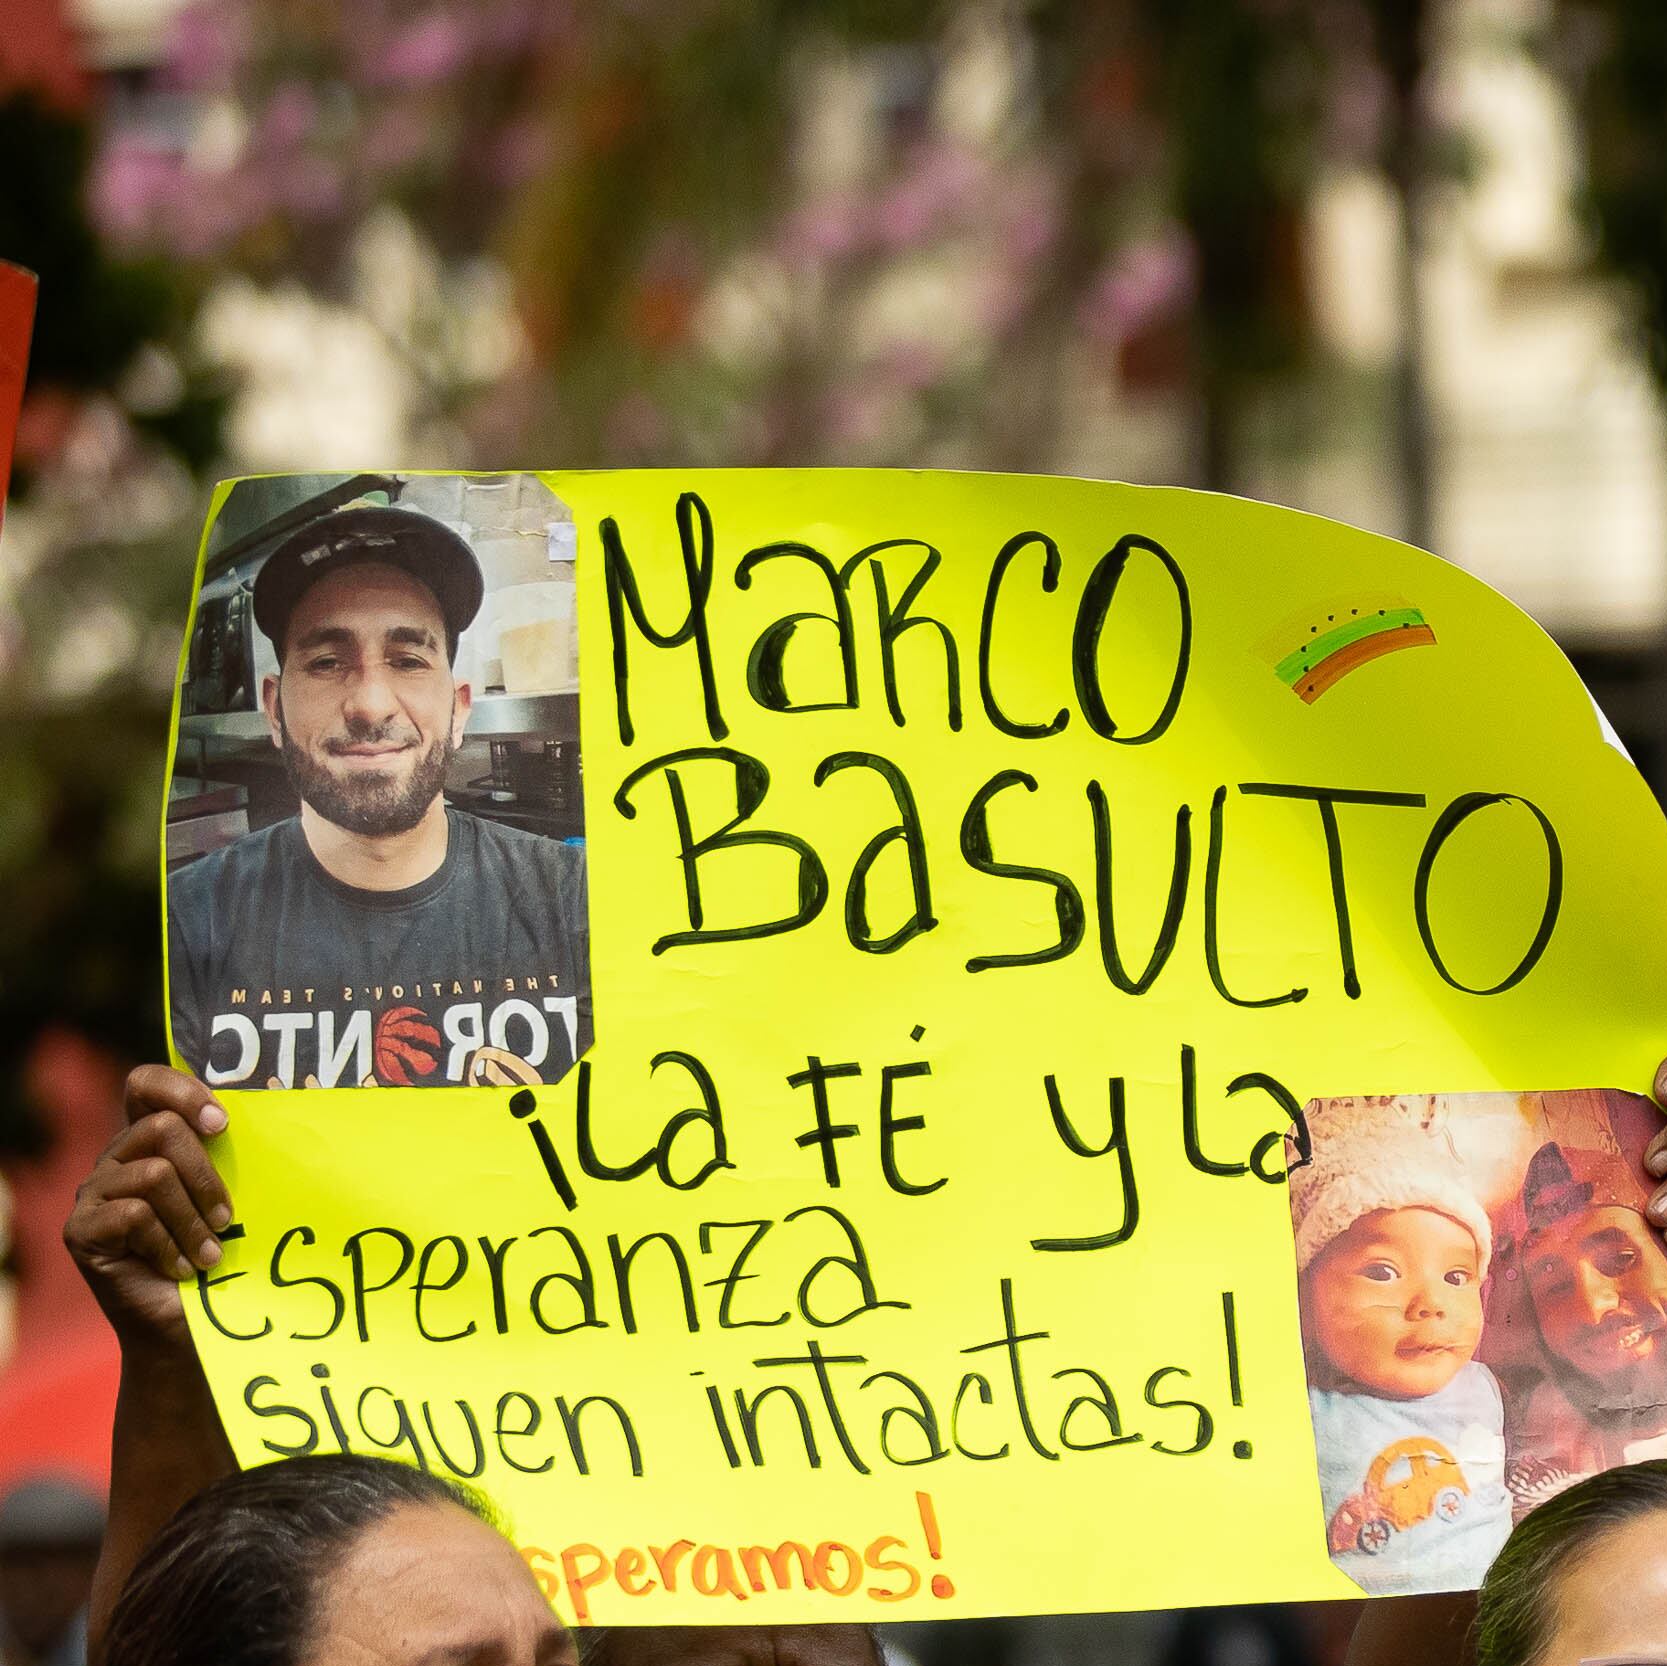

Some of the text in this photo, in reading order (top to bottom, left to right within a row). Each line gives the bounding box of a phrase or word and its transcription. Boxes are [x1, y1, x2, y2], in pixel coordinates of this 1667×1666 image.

[1030, 1073, 1140, 1252] y
[690, 1278, 1254, 1476] intactas!
[520, 1490, 956, 1627] speramos!
